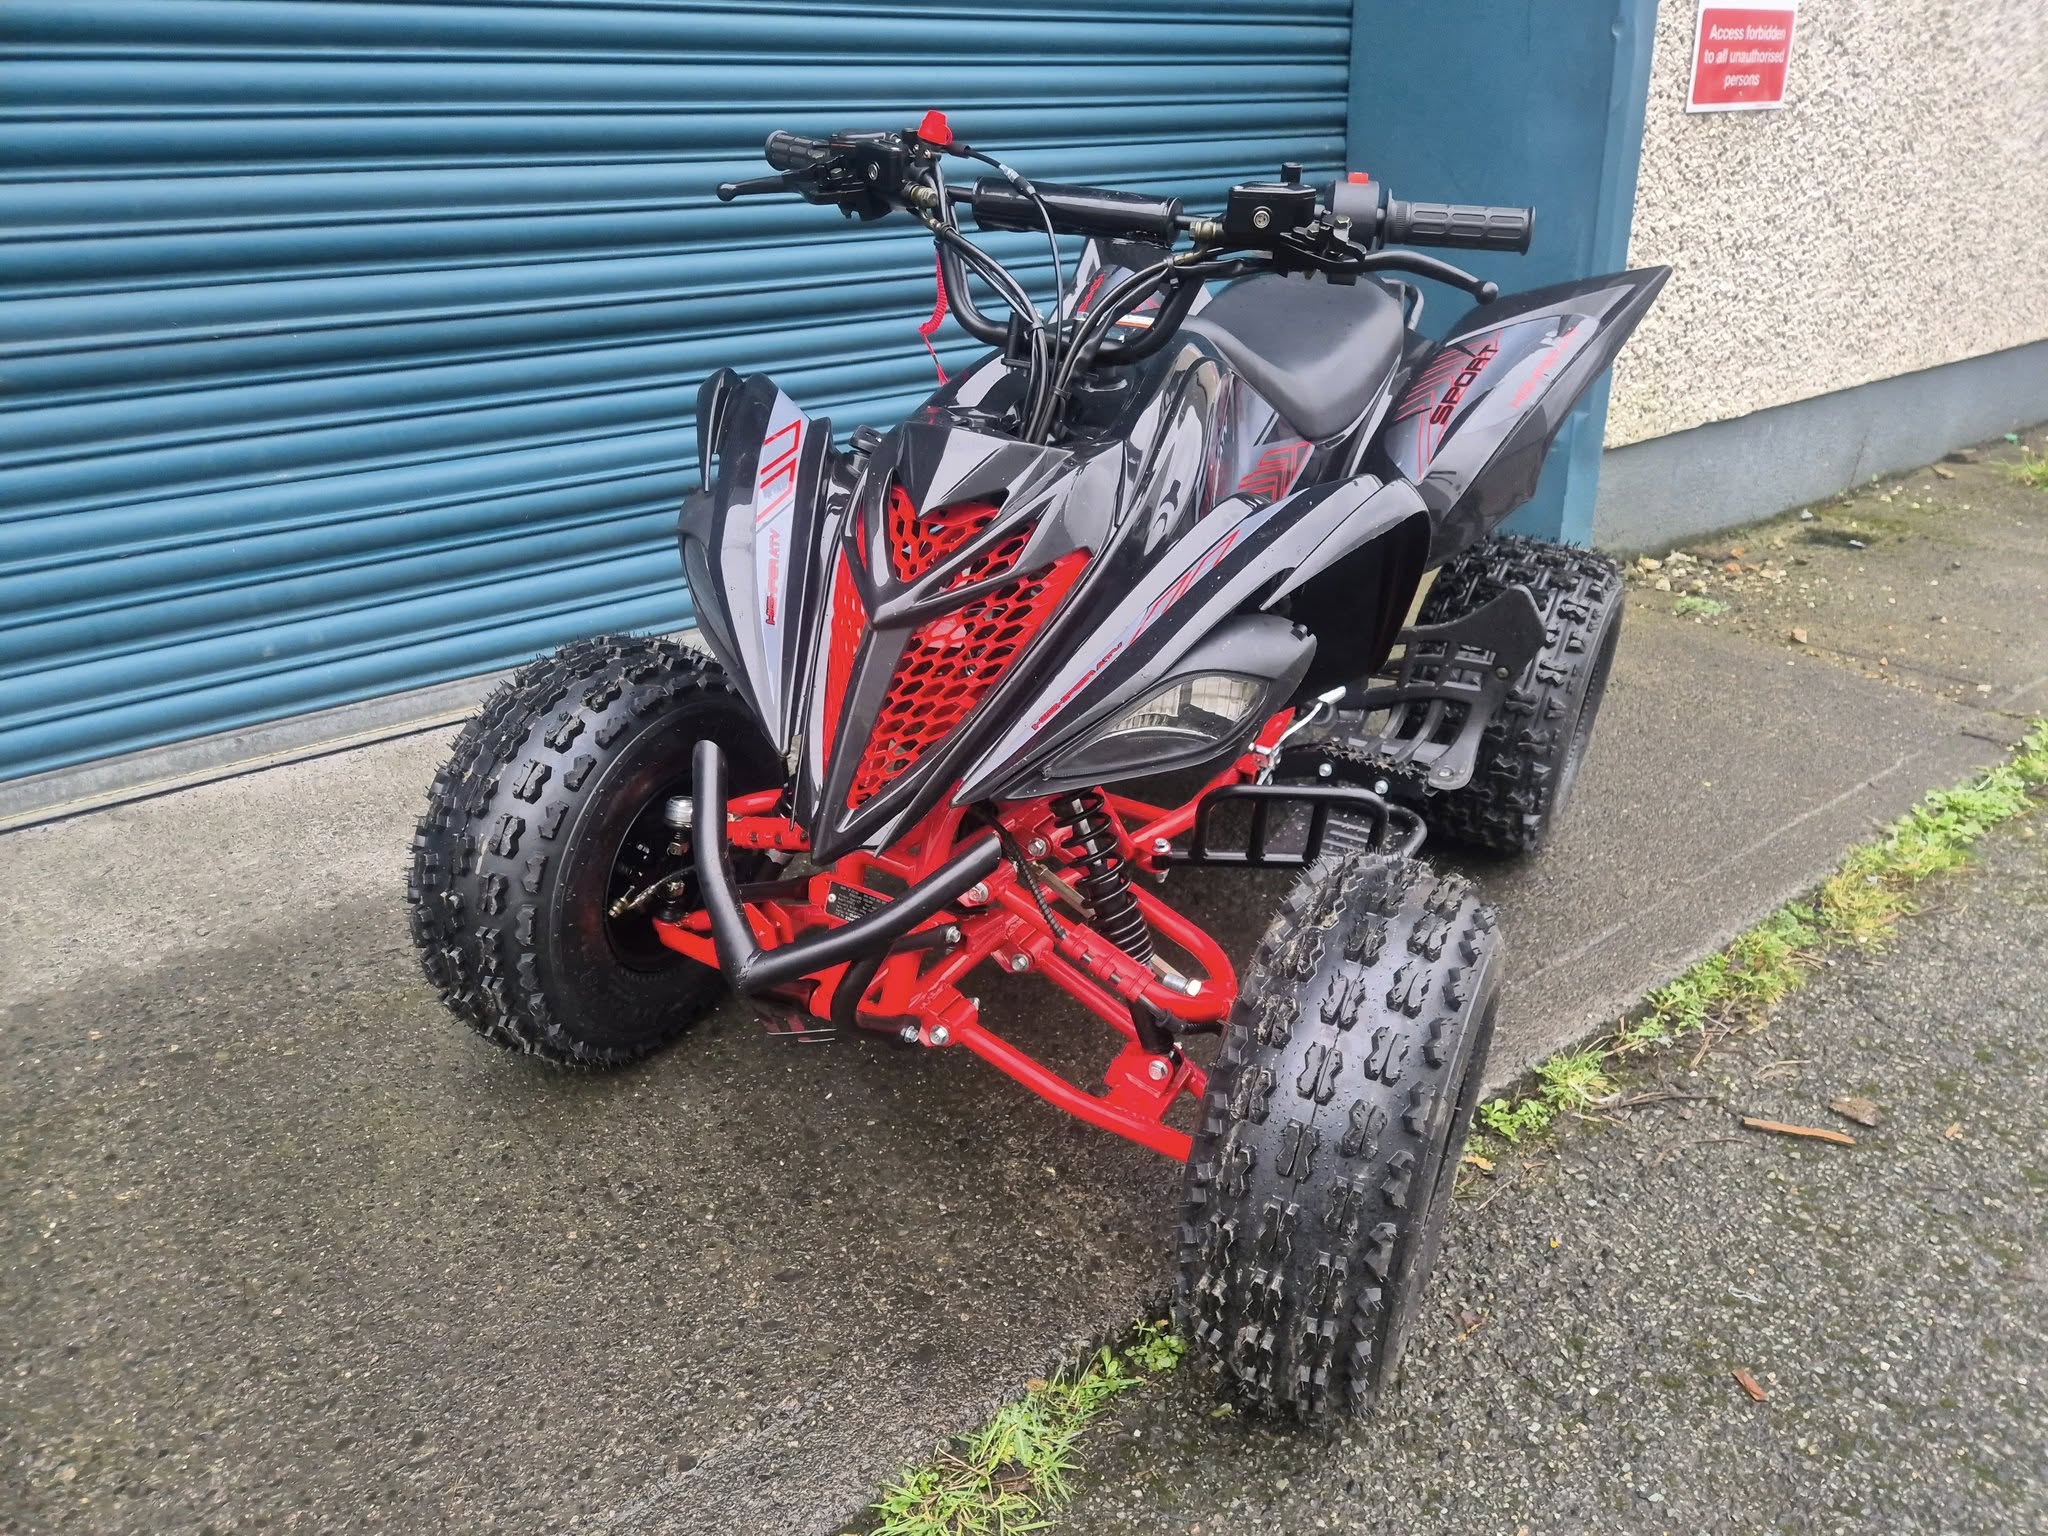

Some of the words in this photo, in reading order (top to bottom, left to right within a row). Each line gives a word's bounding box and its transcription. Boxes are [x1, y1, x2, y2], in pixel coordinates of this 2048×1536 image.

[1708, 24, 1745, 40] Access
[1745, 25, 1787, 41] forbidden
[1704, 49, 1715, 65] to
[1715, 48, 1729, 65] all
[1729, 48, 1786, 64] unauthorised
[1723, 74, 1761, 91] persons
[1429, 344, 1499, 426] SPORT
